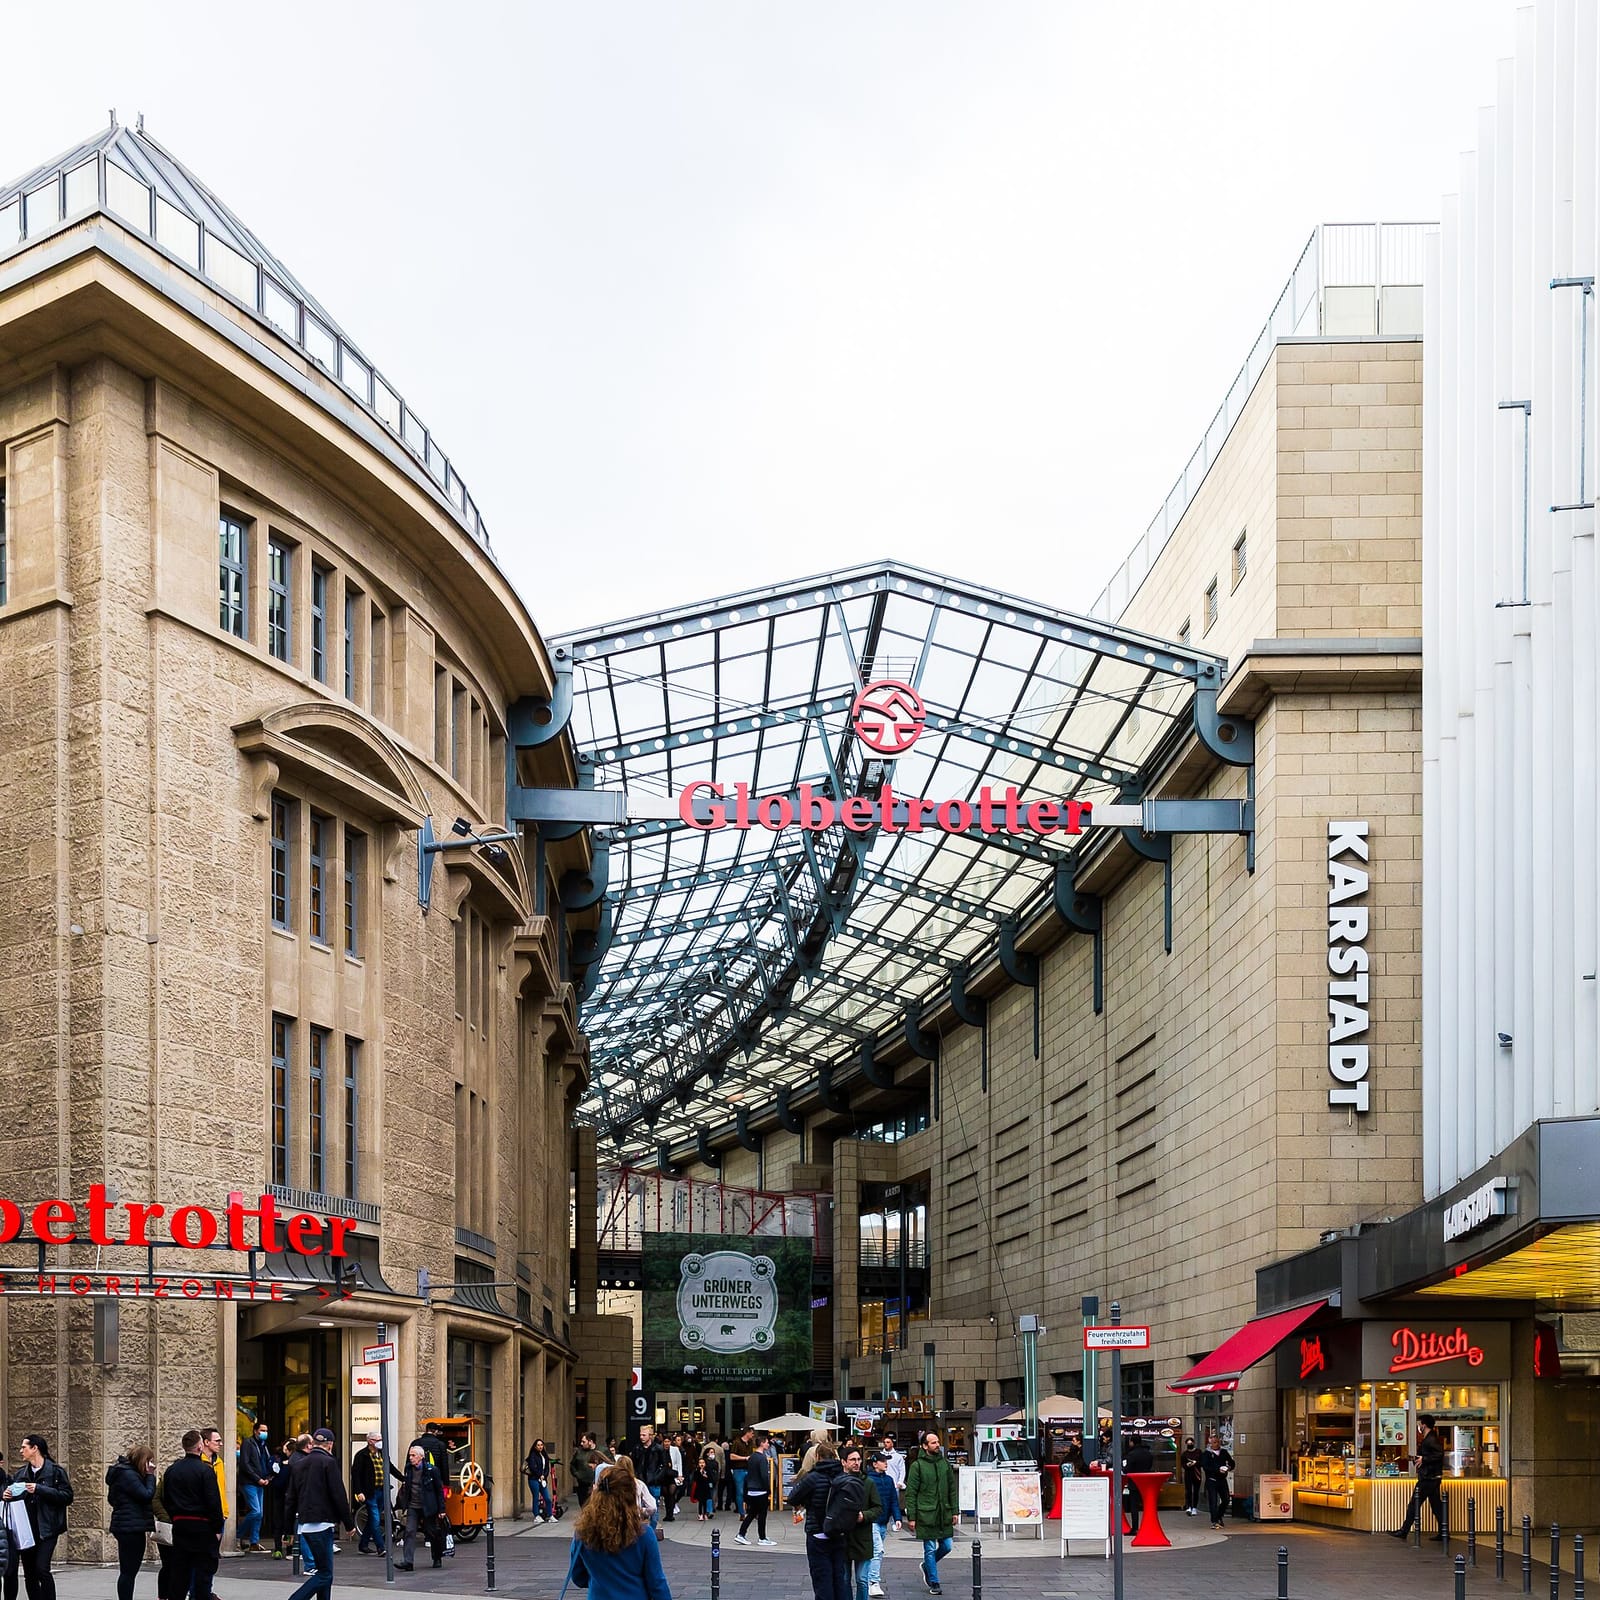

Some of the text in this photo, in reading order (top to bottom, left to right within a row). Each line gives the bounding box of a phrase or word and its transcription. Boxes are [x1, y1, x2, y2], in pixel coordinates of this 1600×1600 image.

[679, 780, 1092, 835] Globetrotter
[1327, 821, 1369, 1112] KARSTADT
[1443, 1176, 1507, 1243] KARSTADT
[38, 1274, 283, 1301] HORIZONTE
[704, 1277, 752, 1294] GRÜNER
[692, 1294, 763, 1309] UNTERWEGS
[1087, 1330, 1146, 1338] Feuerwehrzufahrt
[1391, 1327, 1471, 1364] Ditsch
[701, 1367, 773, 1375] GLOBETROTTER
[634, 1397, 647, 1414] 9
